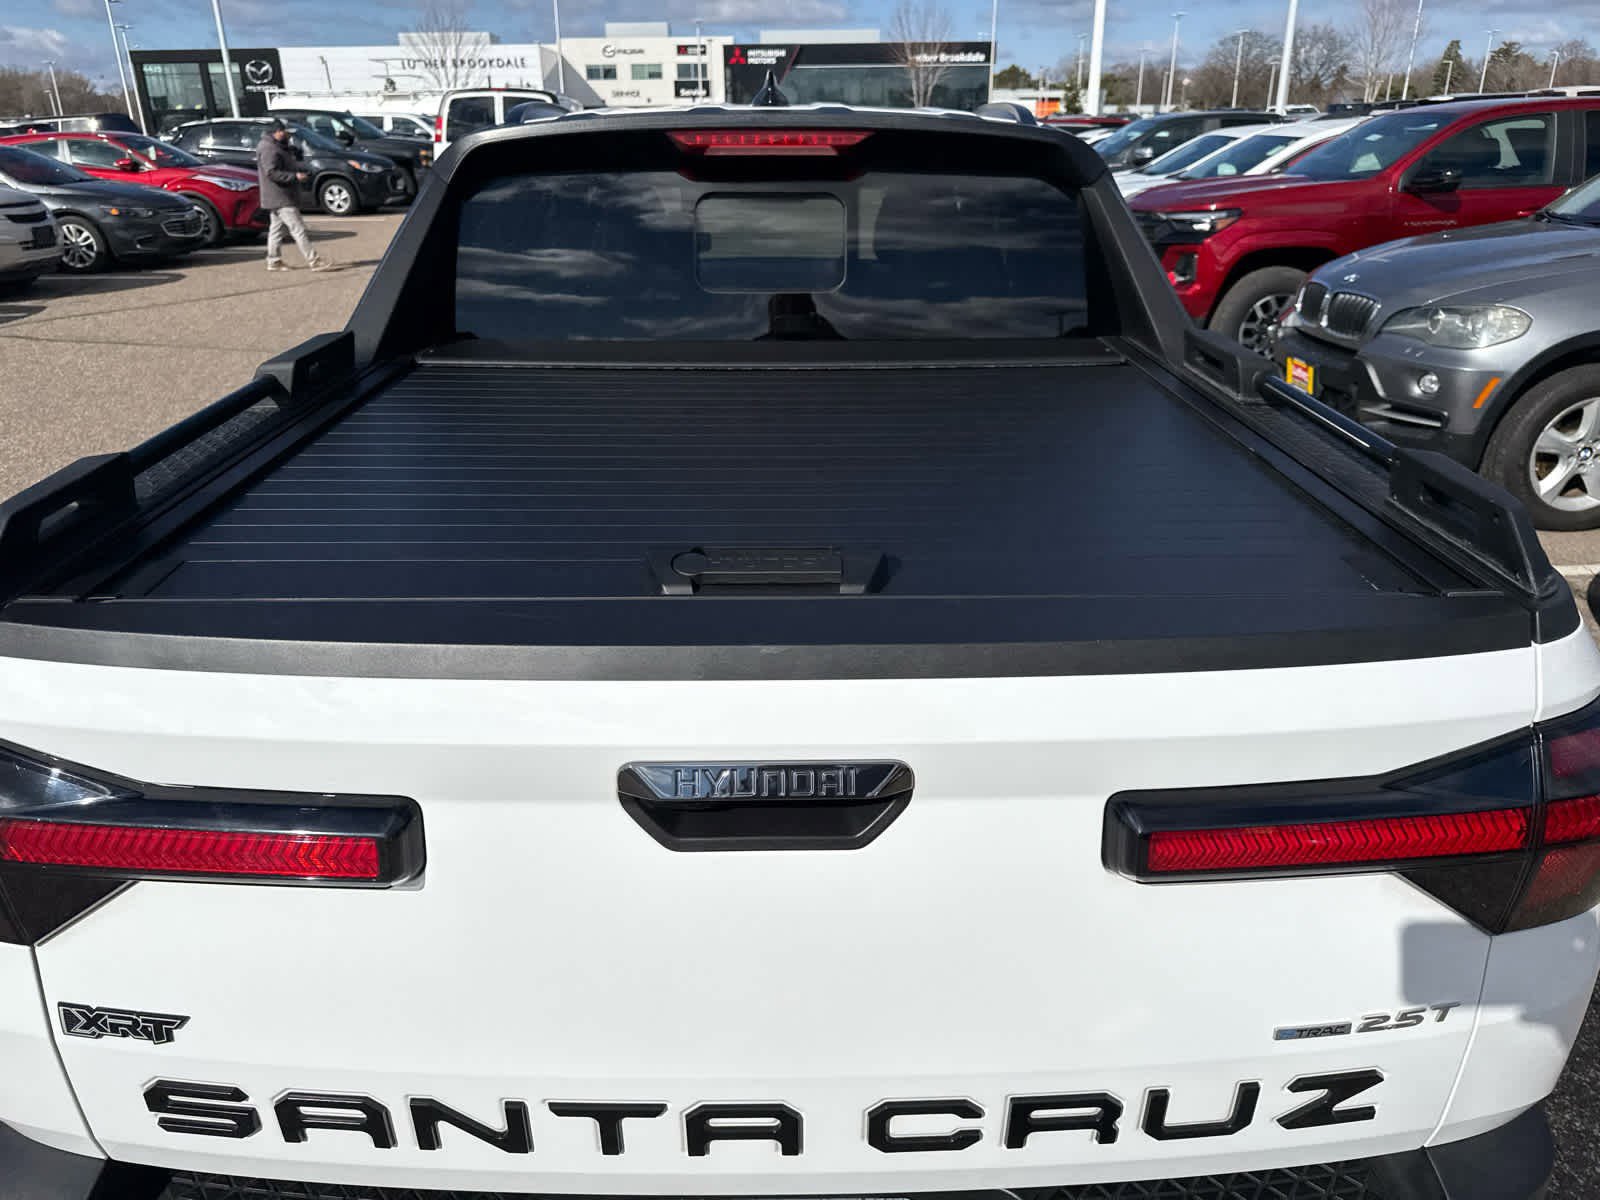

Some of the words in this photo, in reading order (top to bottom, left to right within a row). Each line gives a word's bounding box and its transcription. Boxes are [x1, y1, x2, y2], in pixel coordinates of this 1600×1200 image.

[672, 765, 859, 798] HYUNDAI
[60, 1002, 188, 1045] XRT
[142, 1077, 804, 1157] SANTA
[865, 1067, 1384, 1153] CRUZ
